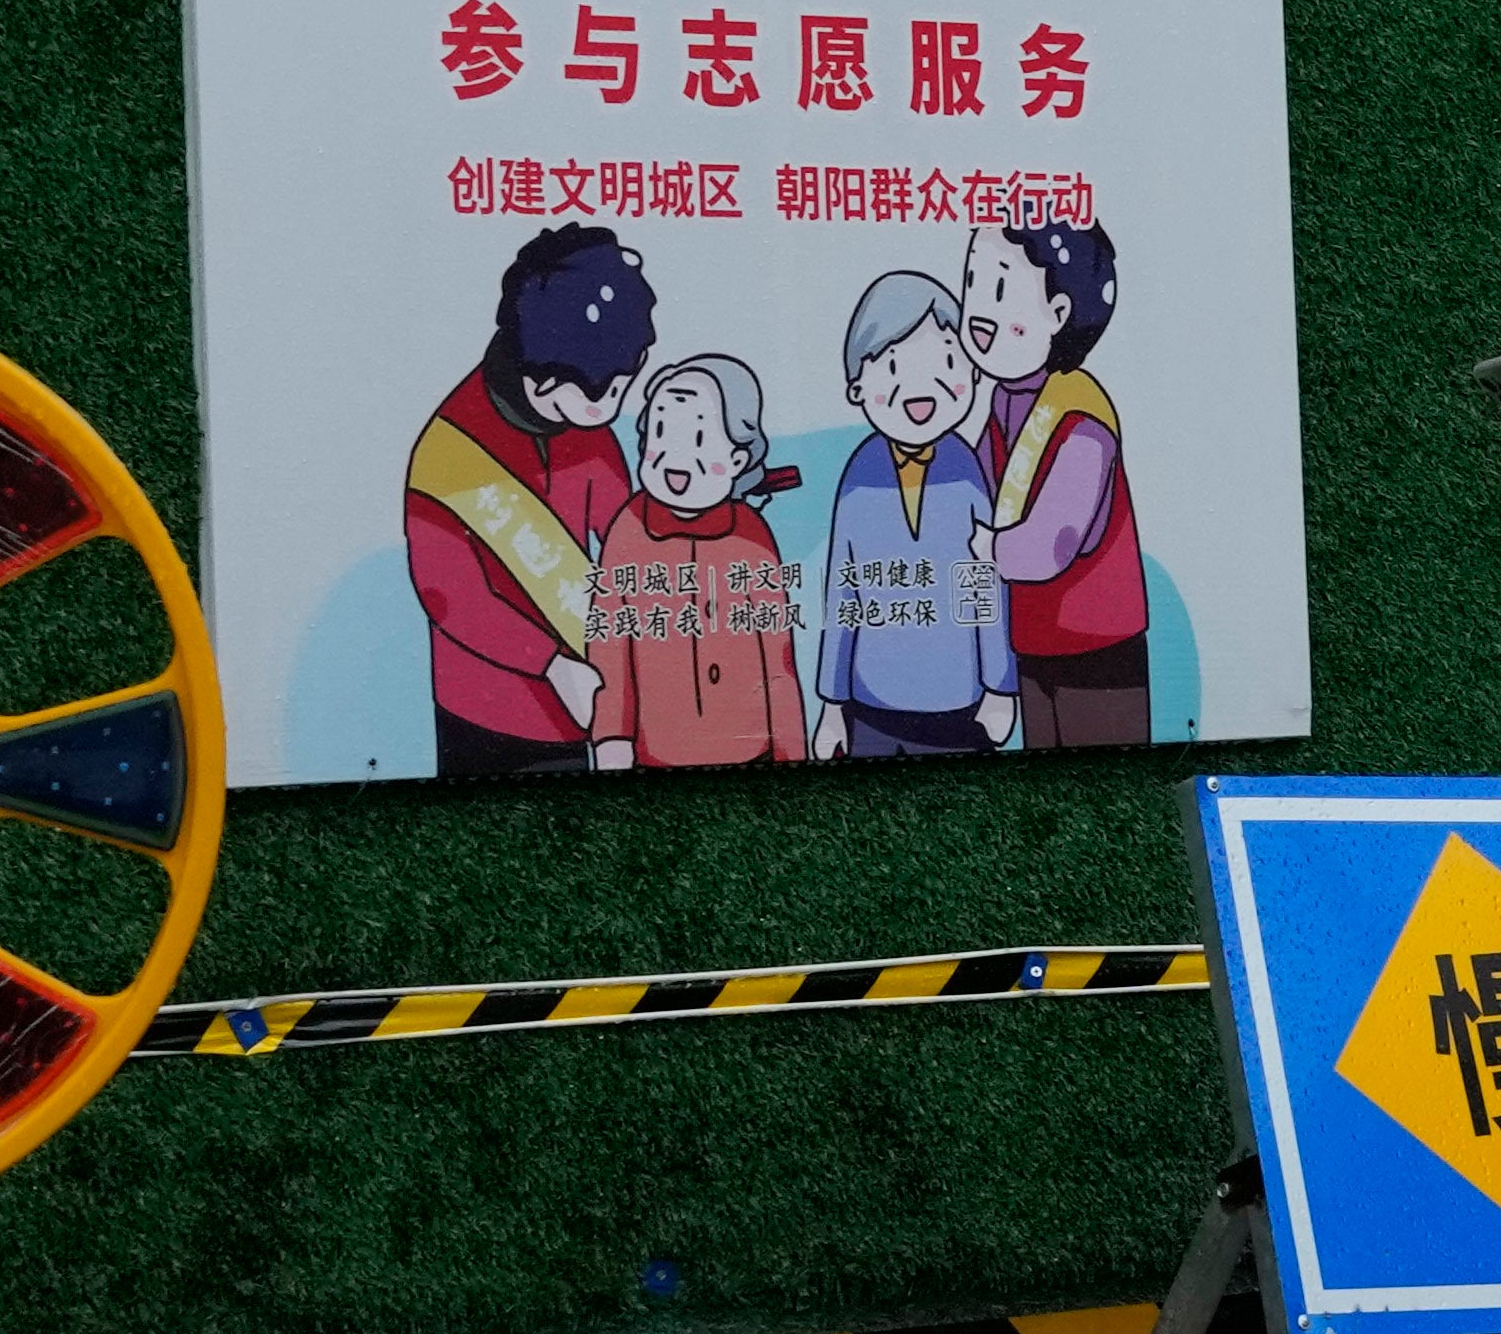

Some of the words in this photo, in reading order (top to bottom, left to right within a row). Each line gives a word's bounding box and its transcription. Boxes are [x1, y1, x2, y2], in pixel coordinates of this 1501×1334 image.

[446, 156, 744, 220] 创建文明城区
[774, 163, 1094, 228] 朝阳群众在行动
[583, 562, 700, 596] 文明城区
[727, 562, 802, 593] 讲文明
[836, 558, 937, 590] 文明健康
[583, 603, 704, 641] 实践有我
[727, 602, 806, 632] 树新风
[836, 598, 938, 628] 绿色环保
